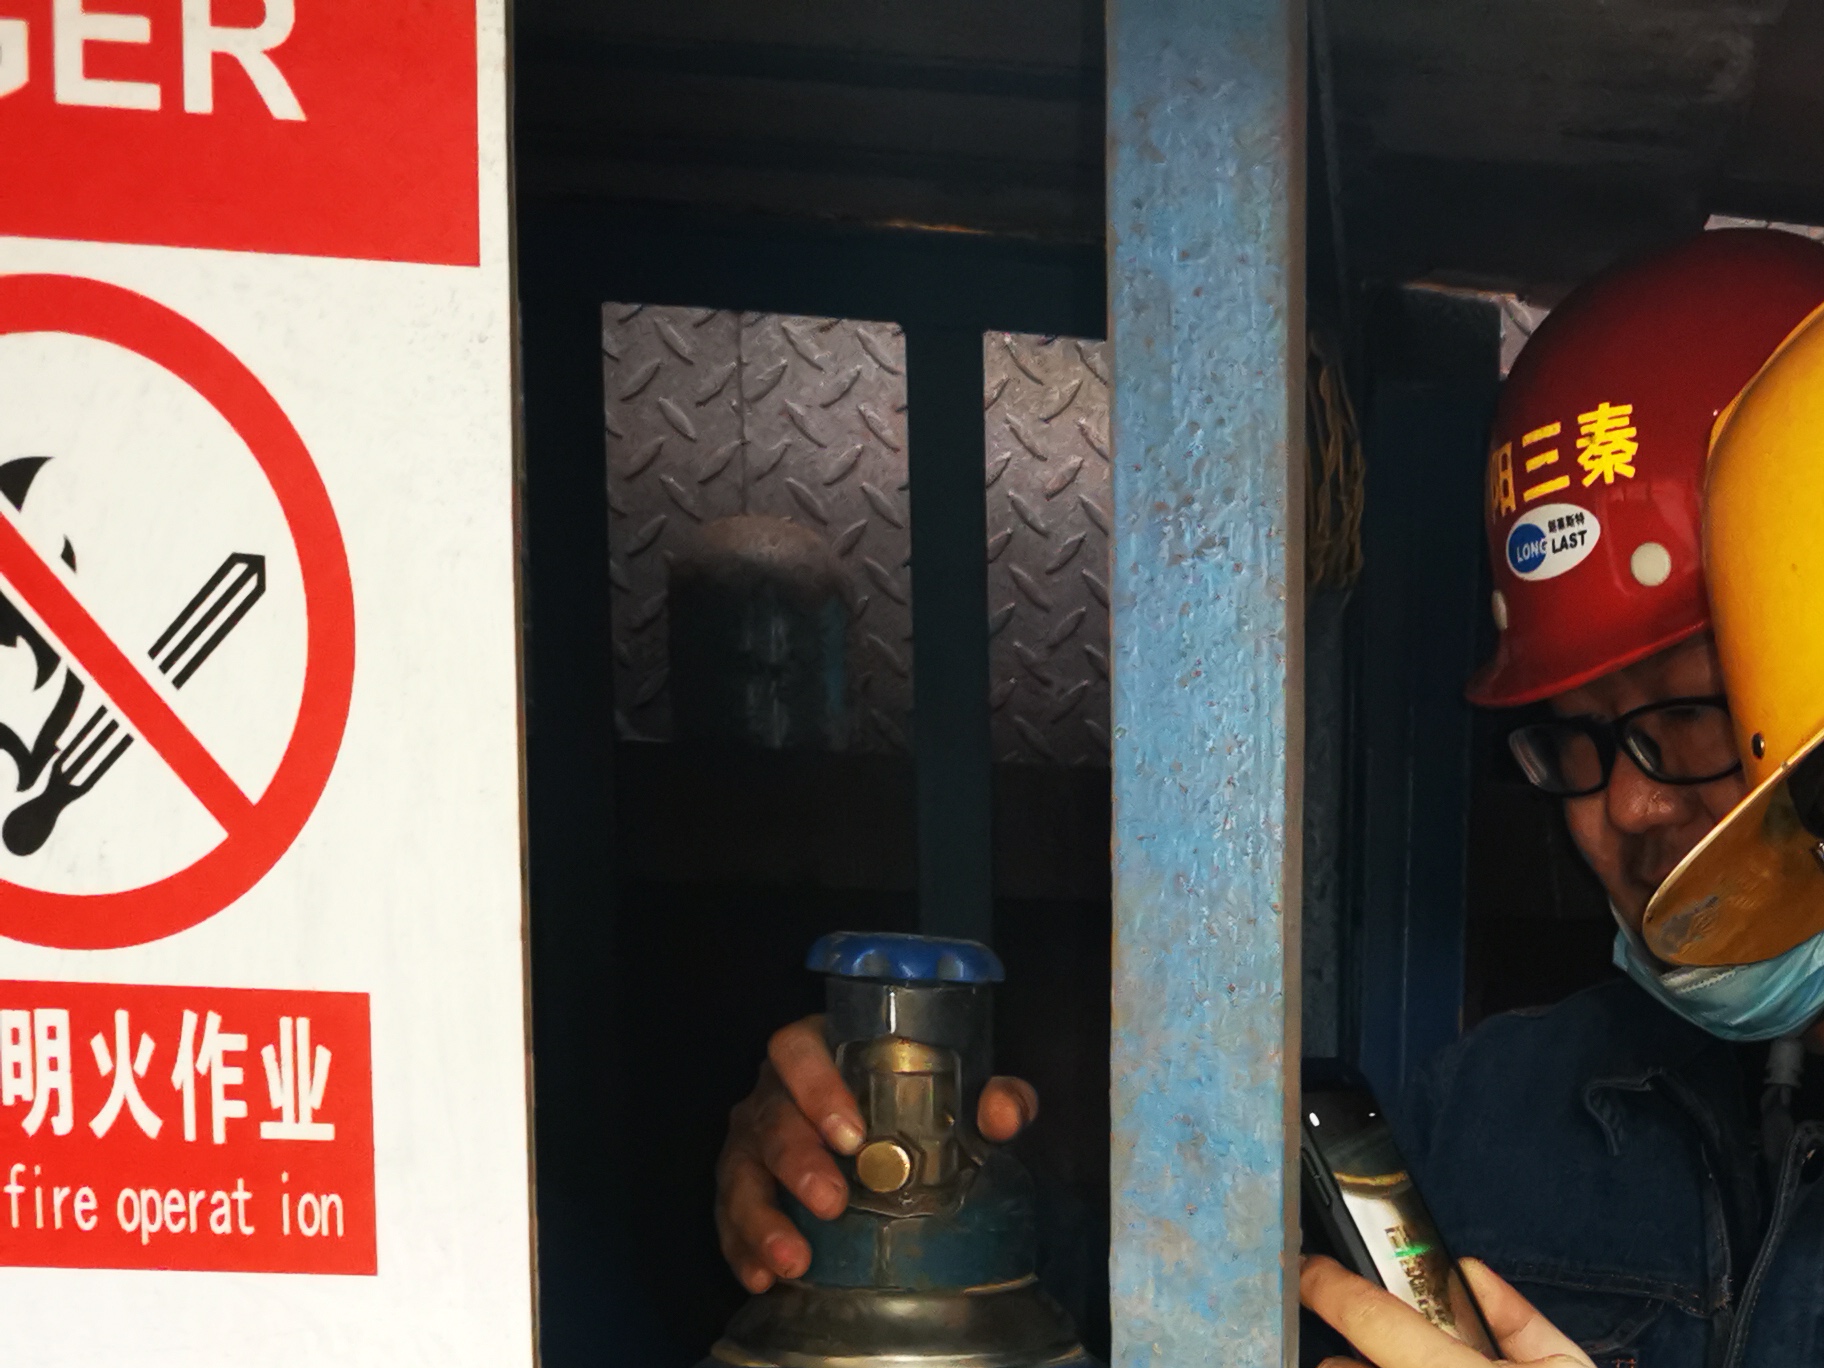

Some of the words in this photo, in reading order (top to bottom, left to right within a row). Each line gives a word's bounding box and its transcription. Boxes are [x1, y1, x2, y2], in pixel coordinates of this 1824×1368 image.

[1552, 530, 1587, 554] LAST
[0, 1008, 335, 1143] 明火作业
[3, 1163, 98, 1231] fire
